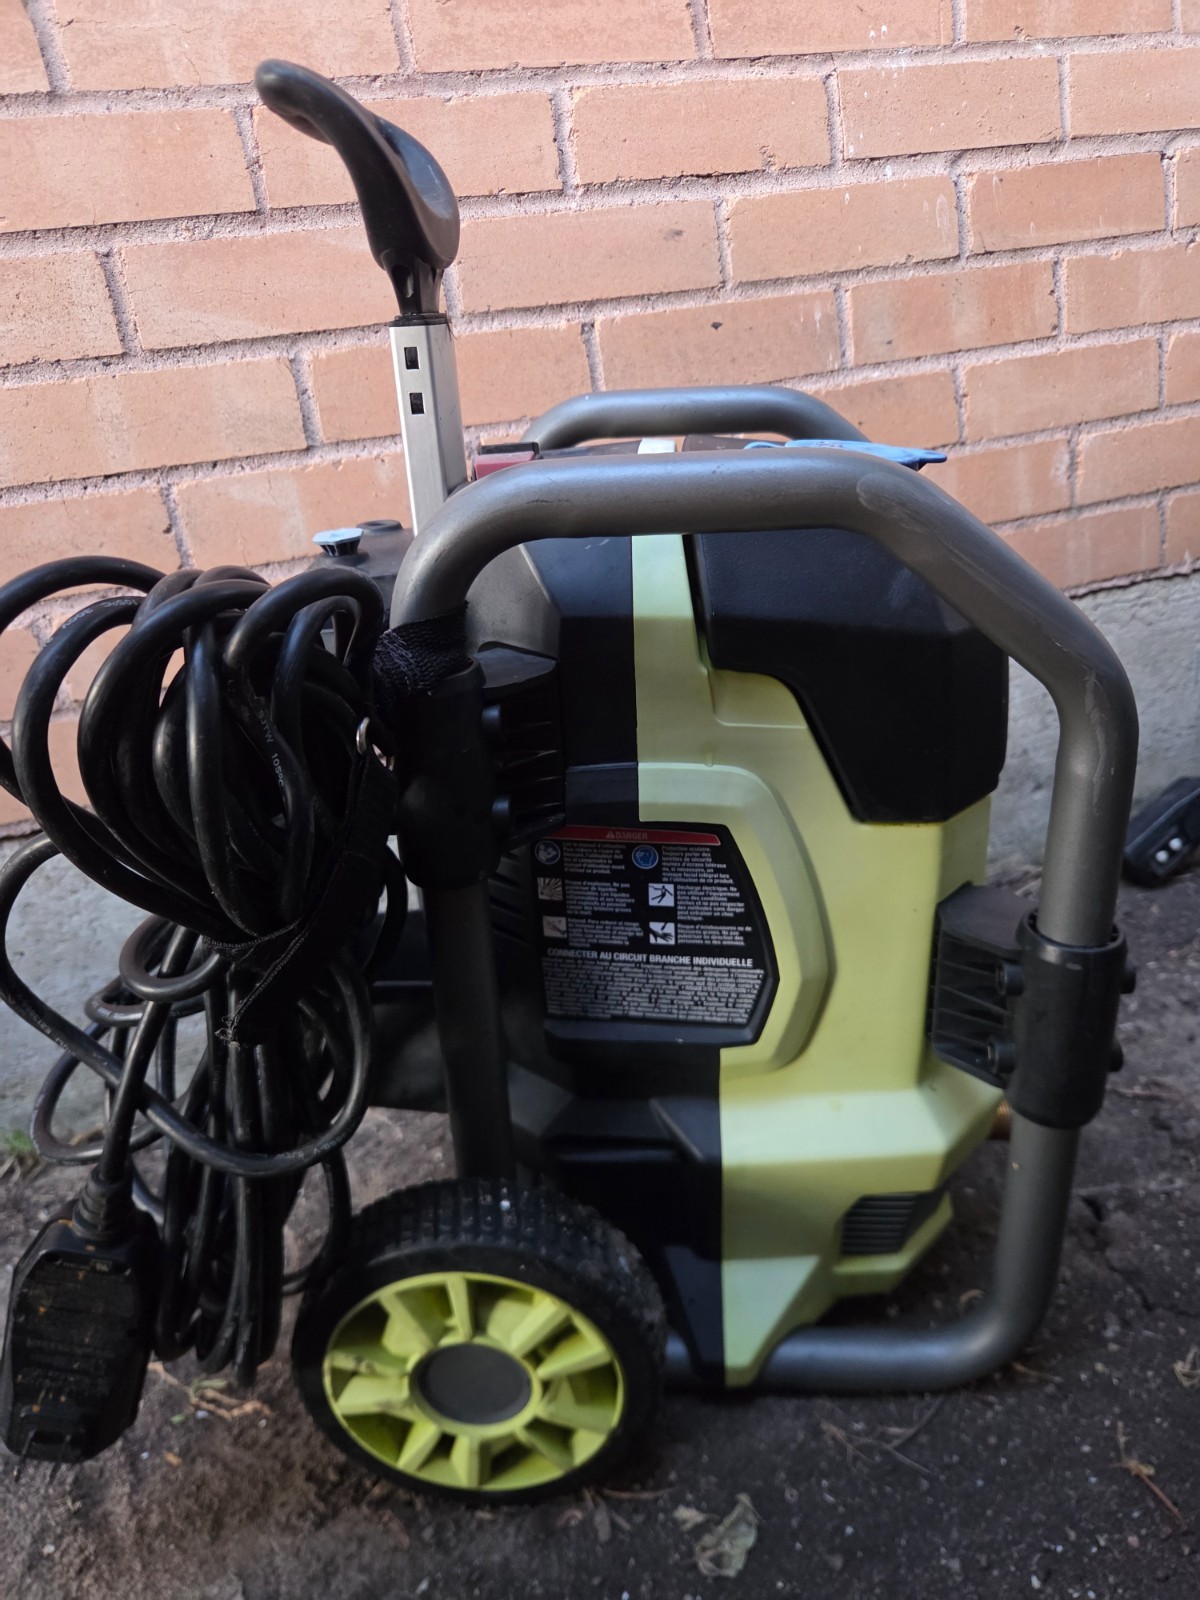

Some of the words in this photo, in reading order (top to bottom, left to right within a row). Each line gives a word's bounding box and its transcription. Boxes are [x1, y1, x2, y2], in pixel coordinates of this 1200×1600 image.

[615, 832, 648, 840] DANGER
[547, 947, 598, 959] CONNECTER
[599, 951, 612, 960] AU
[613, 952, 648, 962] CIRCUIT
[649, 954, 692, 964] BRANCHE
[693, 956, 754, 967] INDIVIDUELLE
